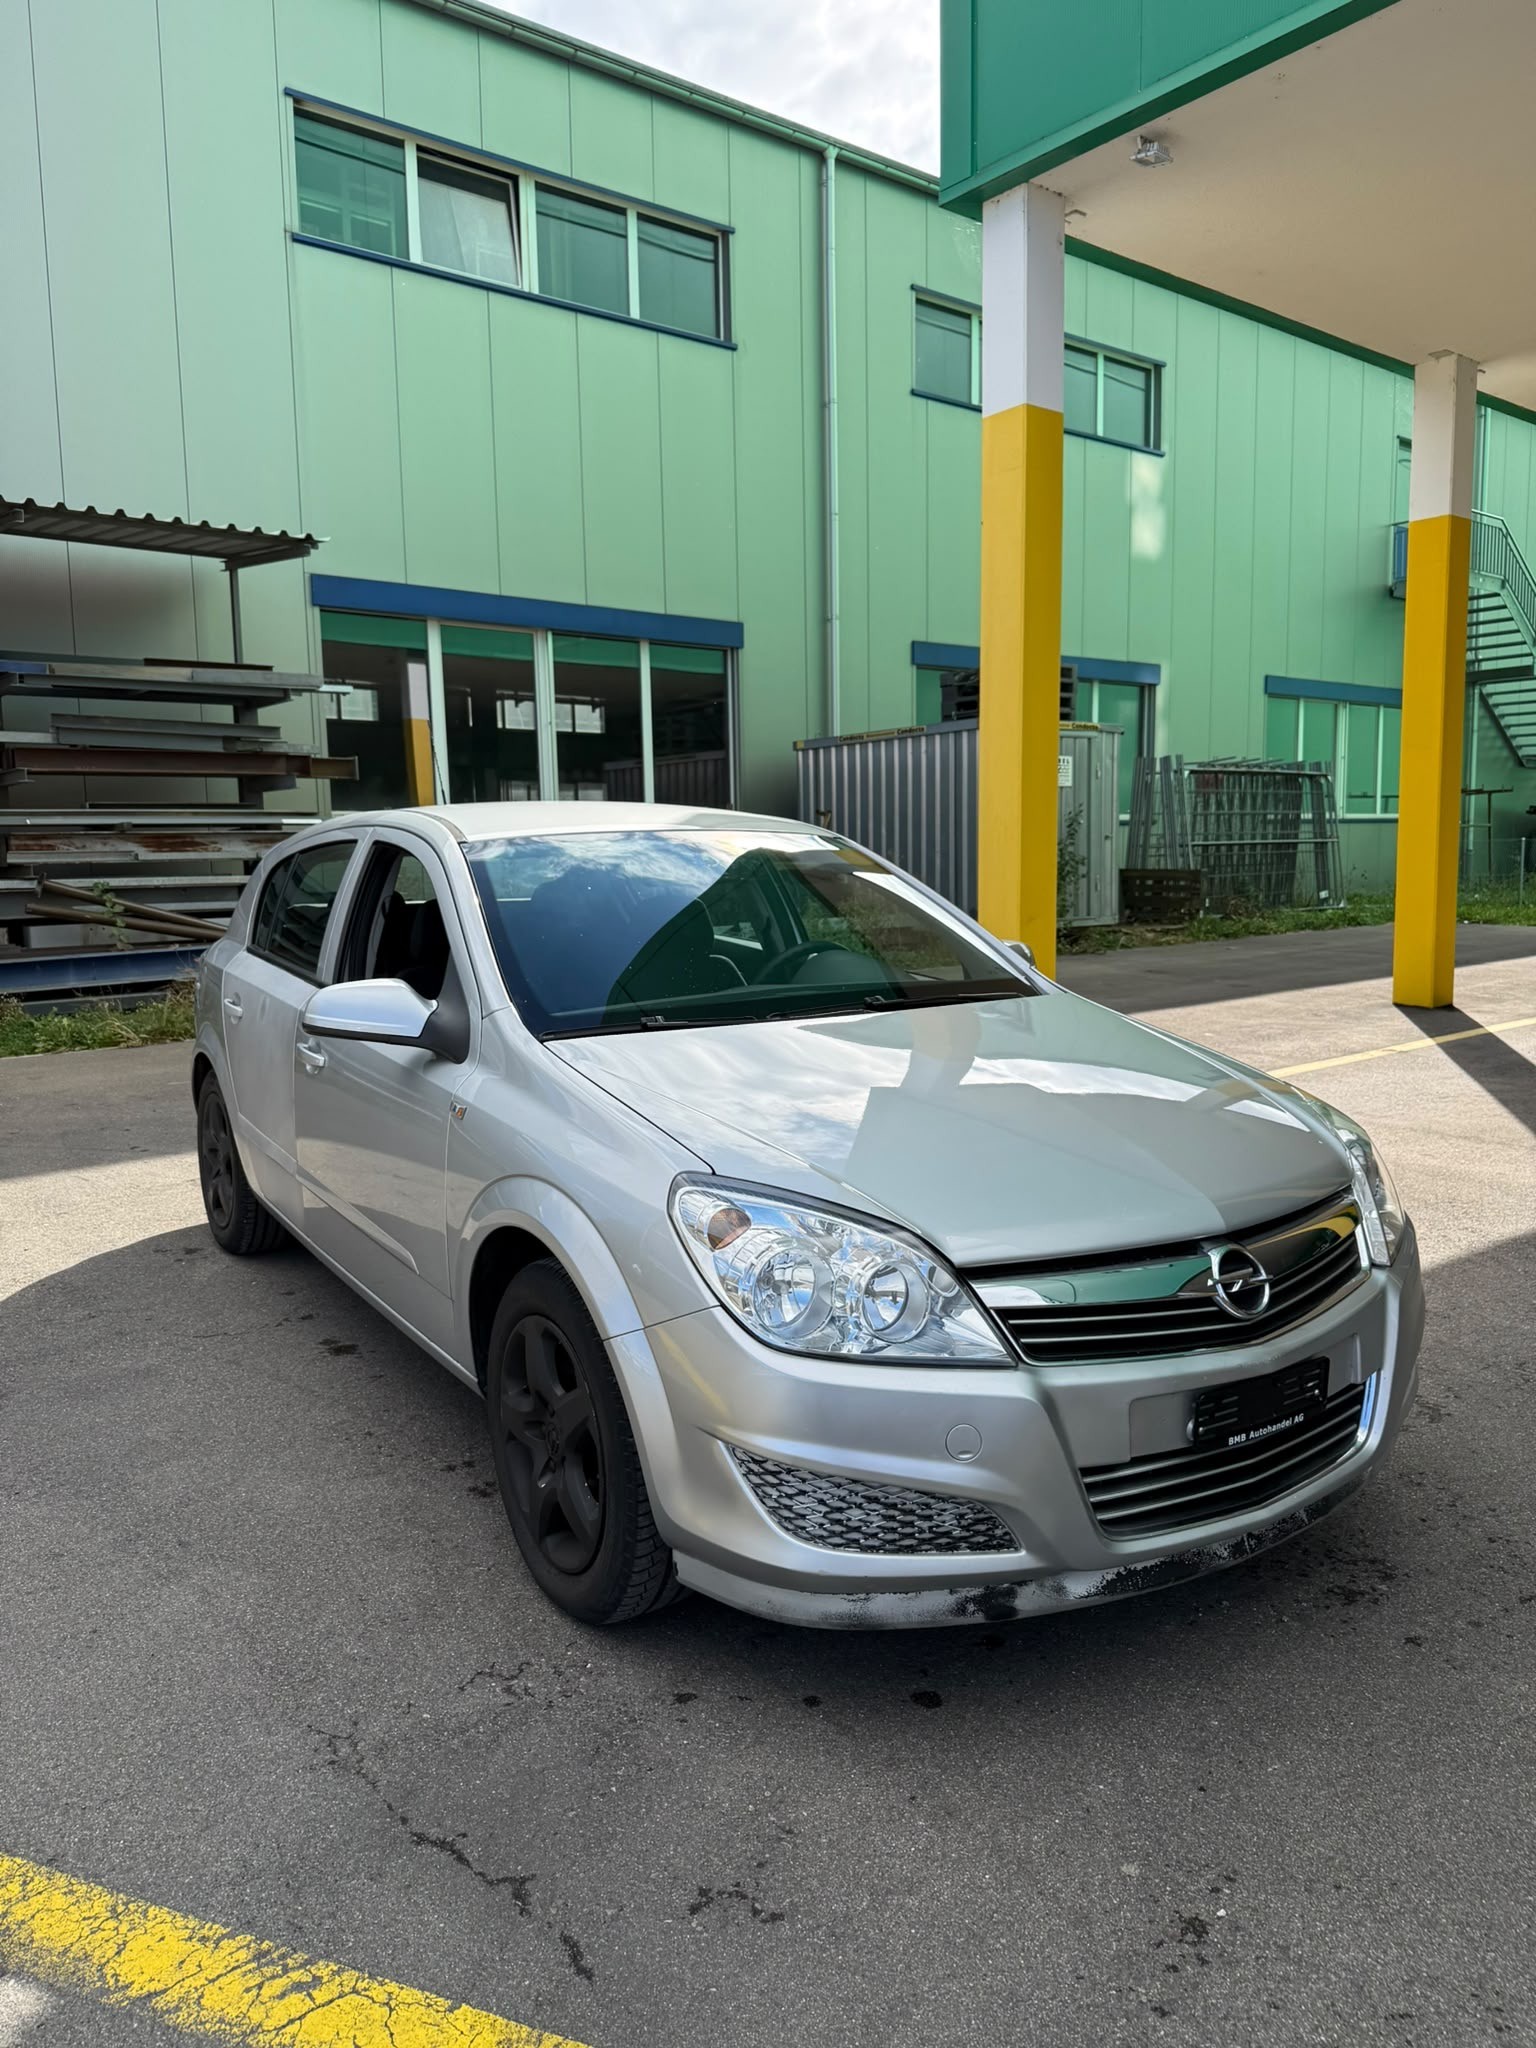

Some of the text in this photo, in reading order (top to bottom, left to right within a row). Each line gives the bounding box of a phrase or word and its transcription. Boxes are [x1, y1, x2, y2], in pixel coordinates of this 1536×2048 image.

[1228, 1413, 1305, 1446] BMB Autohandel AG
